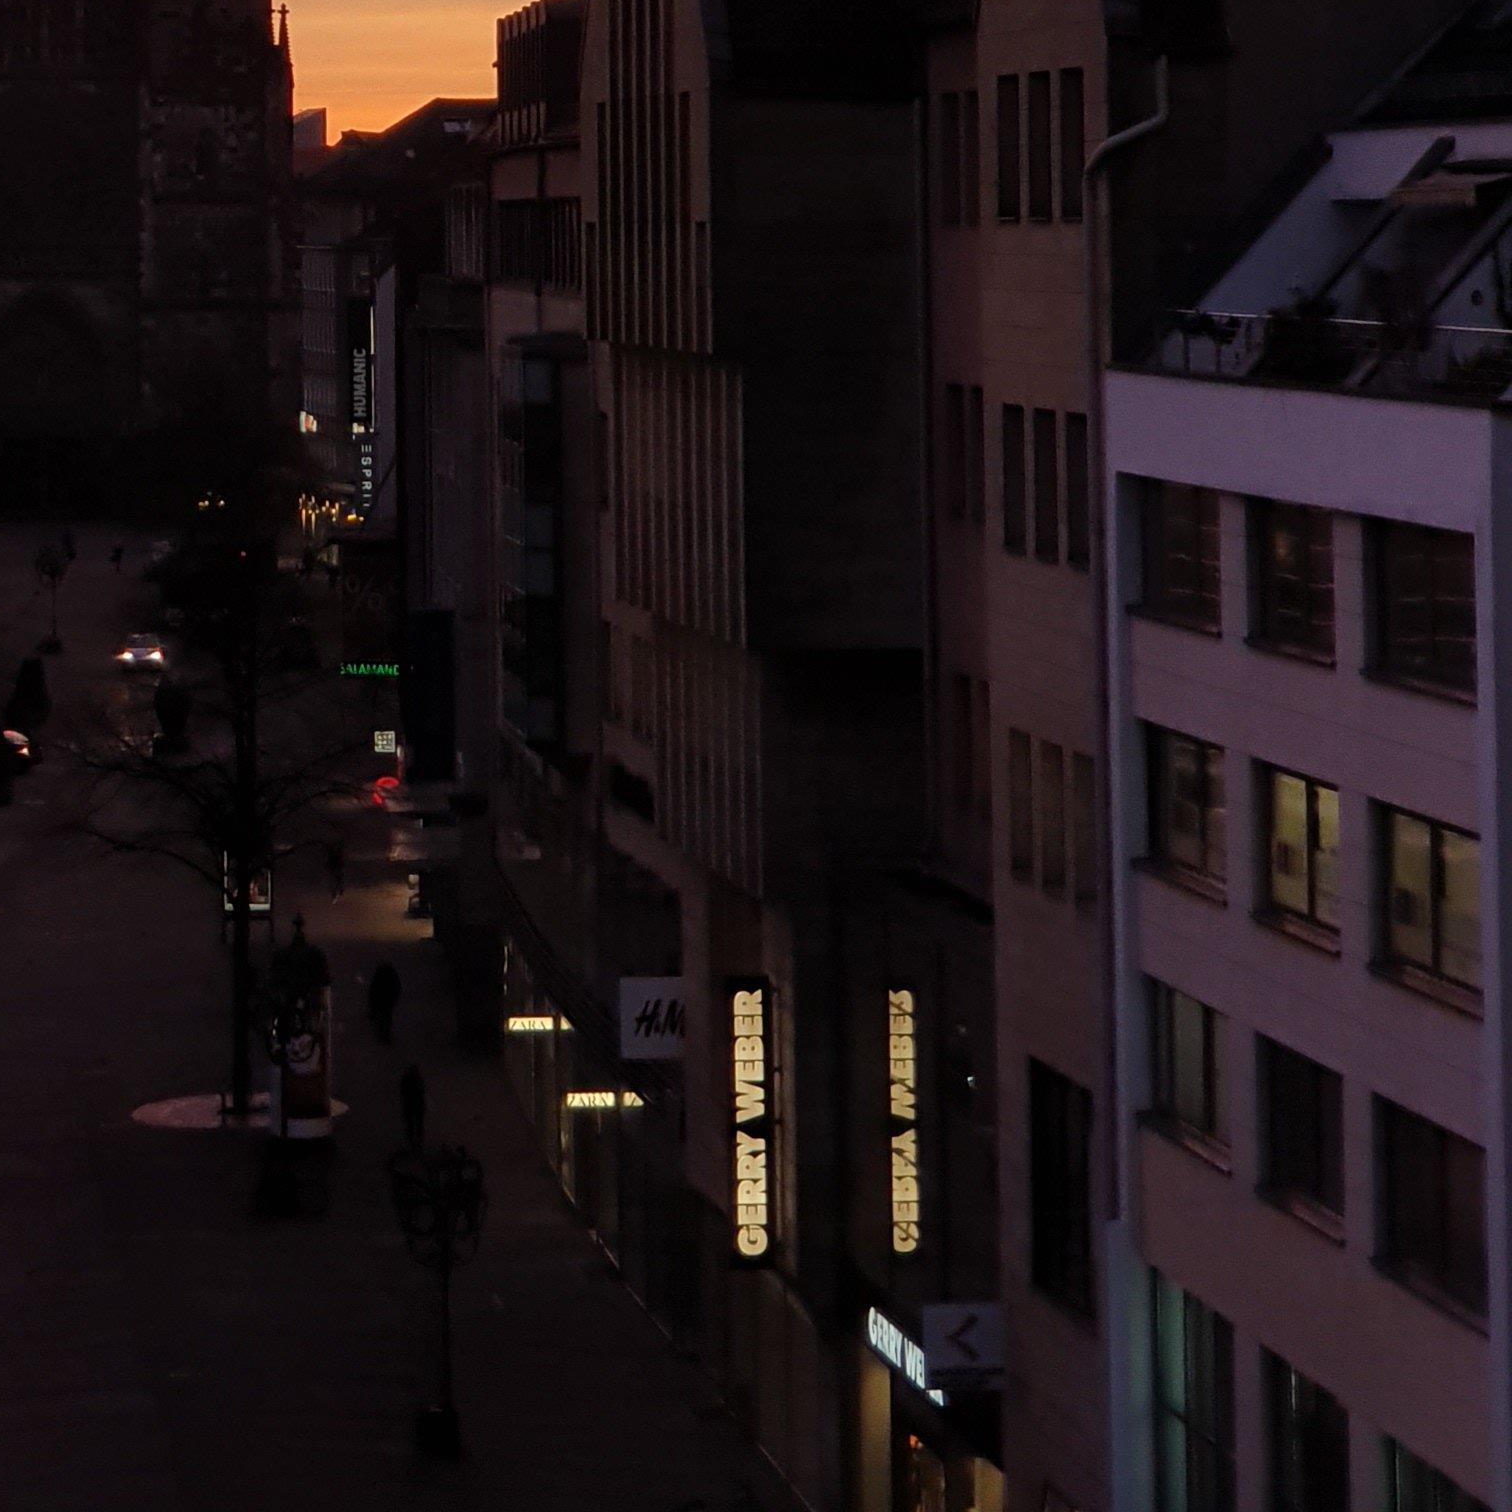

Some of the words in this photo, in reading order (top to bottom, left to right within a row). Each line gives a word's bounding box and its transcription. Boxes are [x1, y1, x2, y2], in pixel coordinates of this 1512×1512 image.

[351, 347, 367, 418] HUMANIC
[734, 989, 765, 1123] WEBER
[737, 1130, 767, 1256] GERRY
[868, 1305, 903, 1369] GERRY
